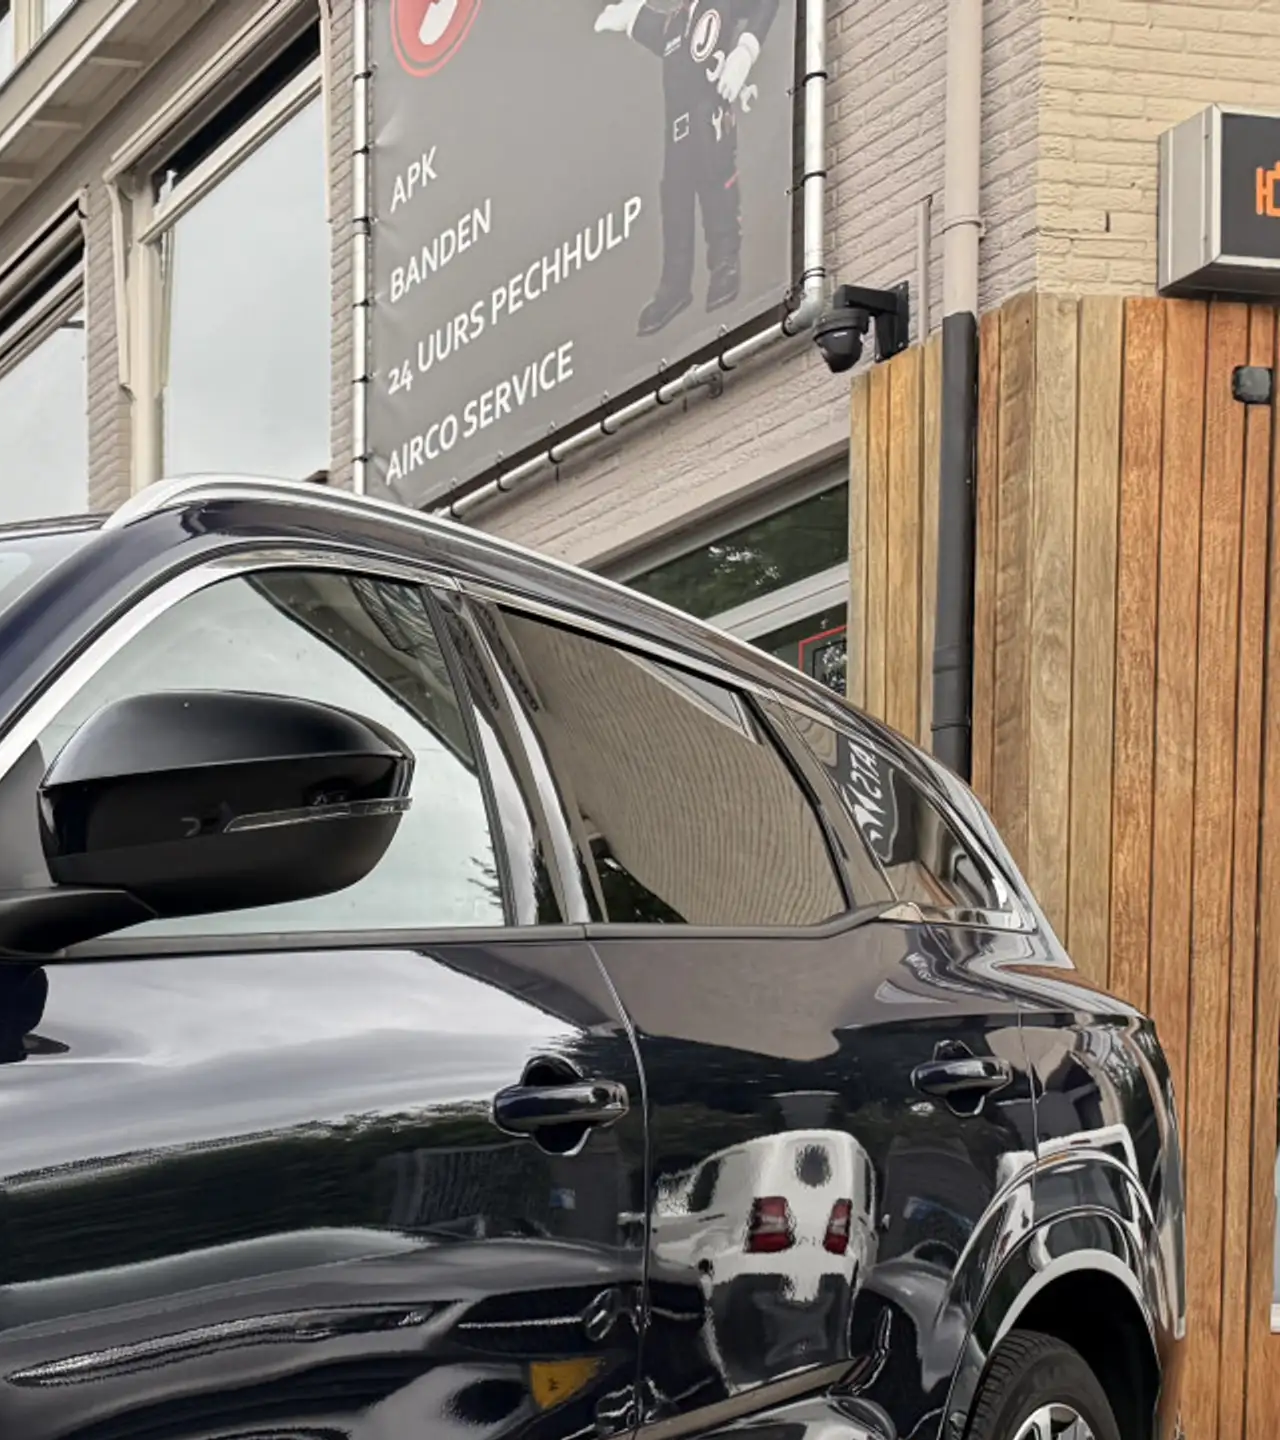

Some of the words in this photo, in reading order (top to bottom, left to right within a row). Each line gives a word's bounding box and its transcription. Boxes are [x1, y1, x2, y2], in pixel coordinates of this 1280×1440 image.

[390, 146, 438, 214] APK
[387, 358, 413, 396] 24
[417, 301, 485, 374] UURS
[491, 196, 642, 325] PECHHULP
[390, 199, 492, 303] BANDEN
[385, 415, 459, 486] AIRCO
[462, 341, 575, 440] SERVICE
